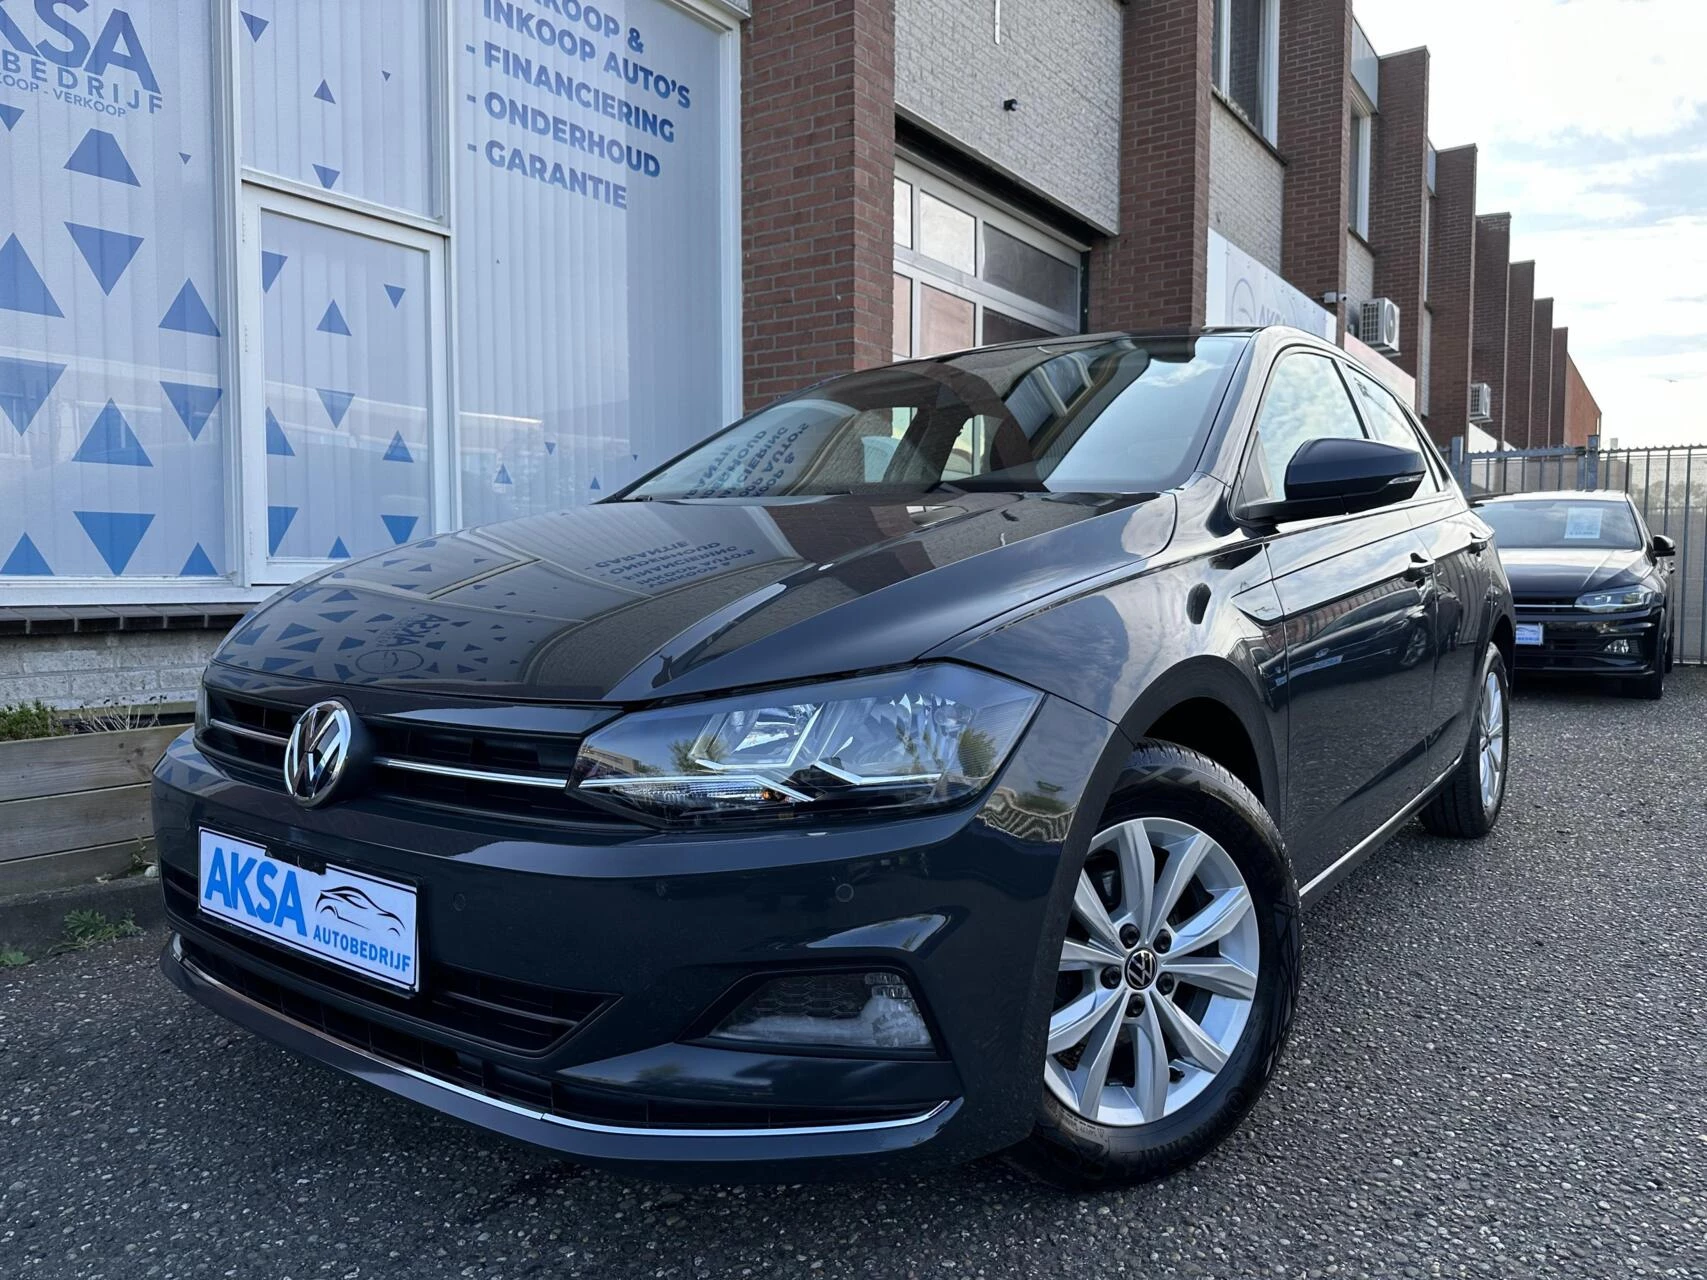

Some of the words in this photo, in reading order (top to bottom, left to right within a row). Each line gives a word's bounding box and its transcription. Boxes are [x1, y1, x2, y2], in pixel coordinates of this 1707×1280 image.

[483, 0, 596, 63] INKOOP
[603, 52, 691, 109] AUTO'S
[627, 27, 645, 54] &
[0, 72, 39, 92] OOP
[53, 88, 126, 117] VERKOOP
[2, 49, 162, 114] BEDRIJF
[484, 40, 675, 143] FINANCIERING
[484, 91, 661, 178] ONDERHOUD
[484, 140, 628, 210] GARANTIE
[204, 847, 308, 937] AKSA
[313, 925, 412, 972] AUTOBEDRIJF
